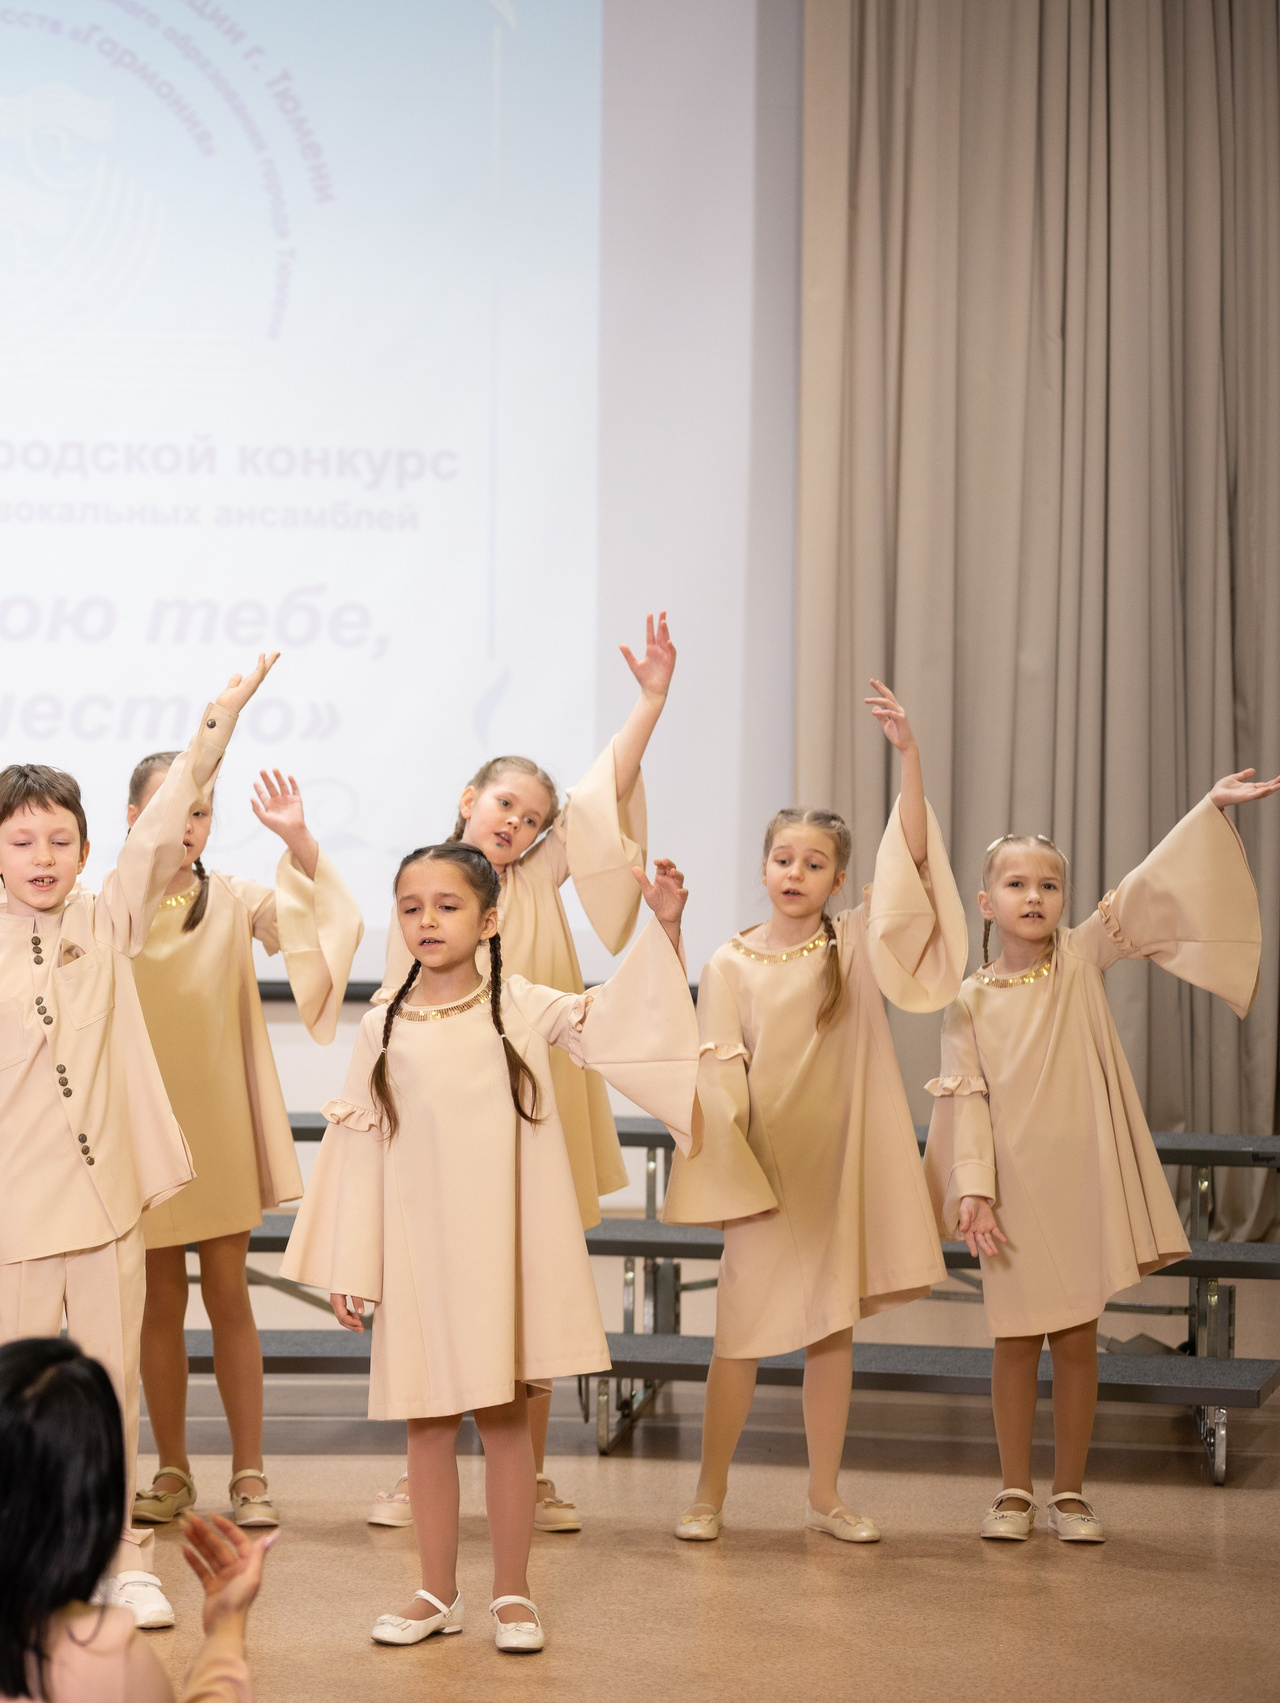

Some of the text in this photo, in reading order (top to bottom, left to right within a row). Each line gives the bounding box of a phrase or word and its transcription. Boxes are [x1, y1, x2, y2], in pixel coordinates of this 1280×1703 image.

[69, 22, 216, 158] «Гармония»
[162, 26, 269, 154] образования
[258, 157, 291, 240] города
[265, 68, 335, 205] Тюмени
[214, 502, 420, 532] ансамблей
[238, 444, 460, 490] конкурс
[145, 582, 391, 663] тебе,
